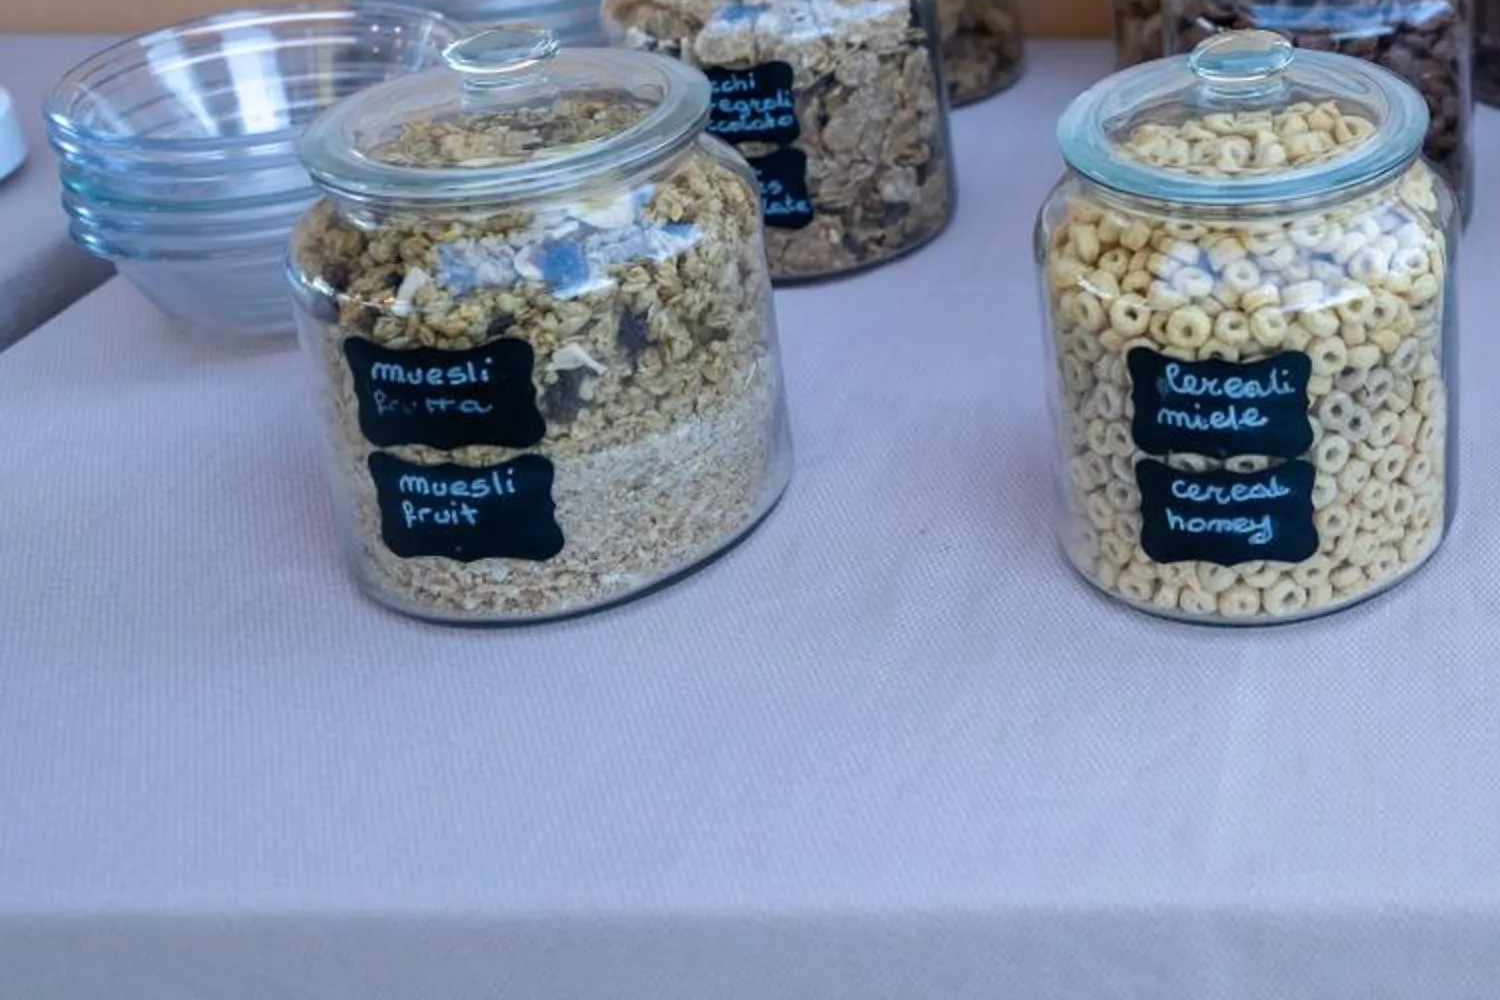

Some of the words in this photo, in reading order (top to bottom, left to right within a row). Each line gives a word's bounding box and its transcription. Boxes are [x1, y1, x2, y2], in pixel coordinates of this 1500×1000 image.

[710, 72, 756, 93] cchi
[711, 89, 793, 119] egrali
[371, 357, 493, 385] muesli
[1157, 402, 1271, 430] miele
[399, 468, 516, 498] muesli
[401, 500, 479, 529] fruit
